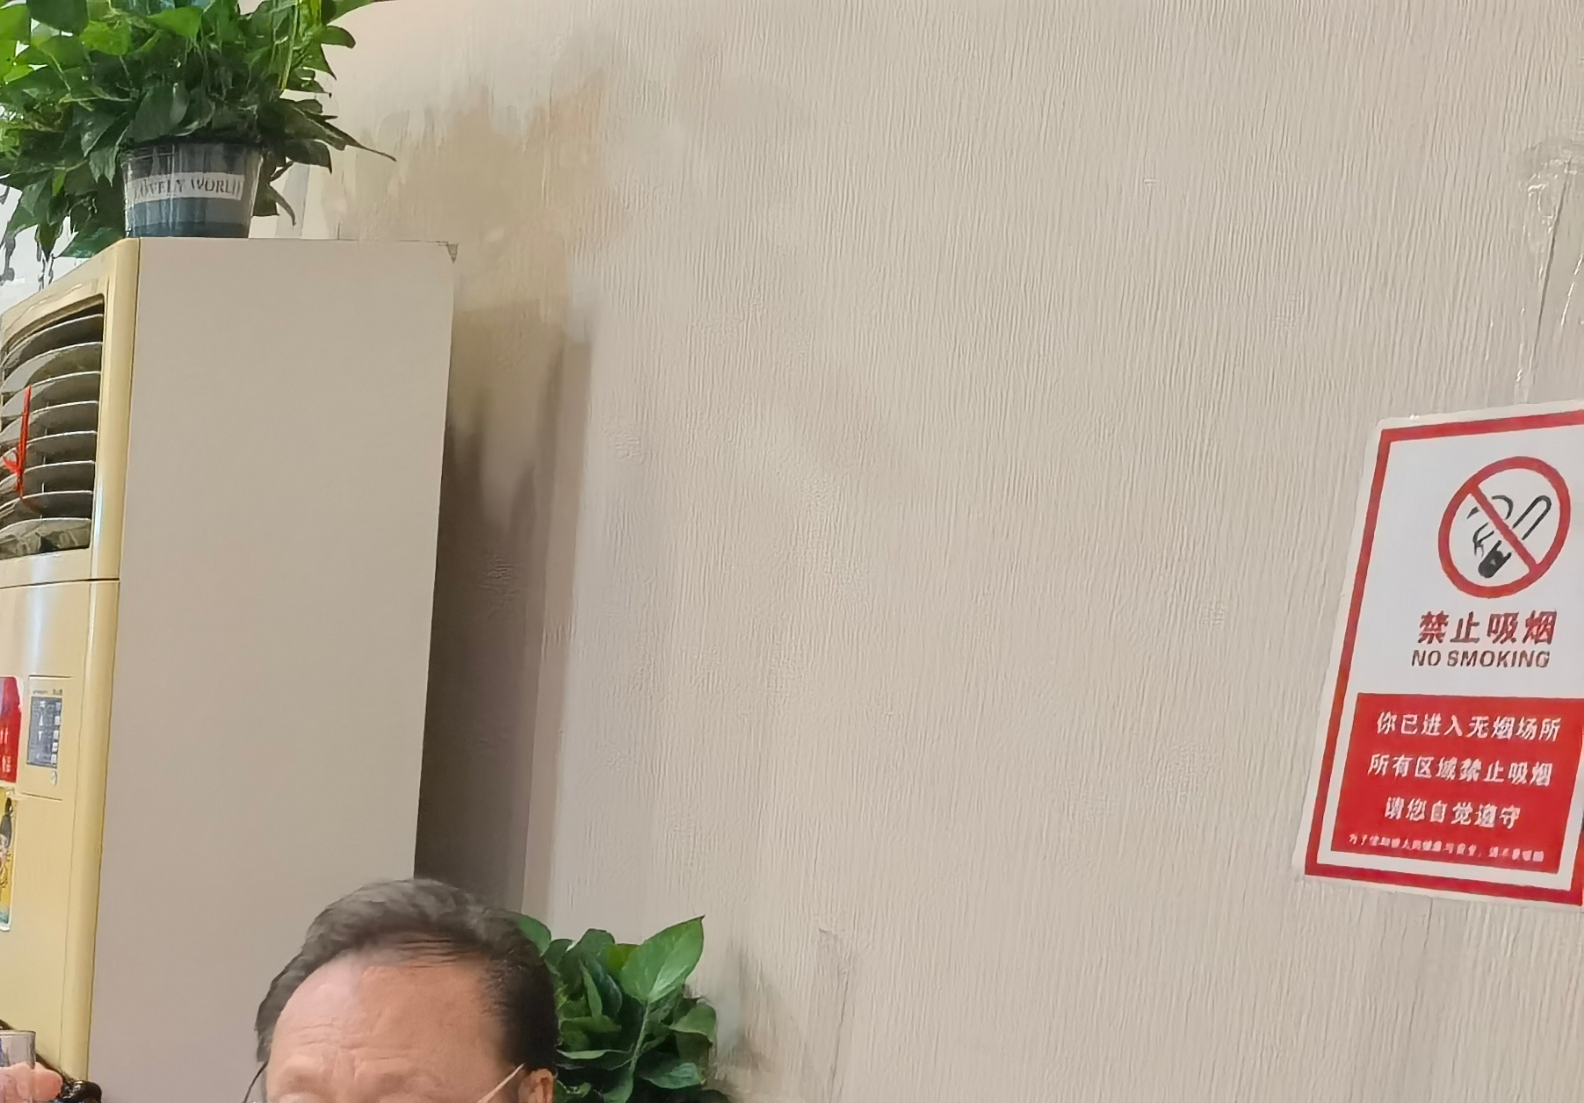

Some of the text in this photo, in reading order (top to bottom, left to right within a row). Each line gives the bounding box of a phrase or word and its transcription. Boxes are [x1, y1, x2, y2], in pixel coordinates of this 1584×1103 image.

[1418, 609, 1558, 645] 禁止吸烟
[1411, 649, 1551, 669] NO SMOKING
[1376, 711, 1562, 742] 你已进入无烟场所
[1367, 753, 1553, 787] 所有区域禁止吸烟
[1384, 796, 1522, 830] 请您自觉遵守
